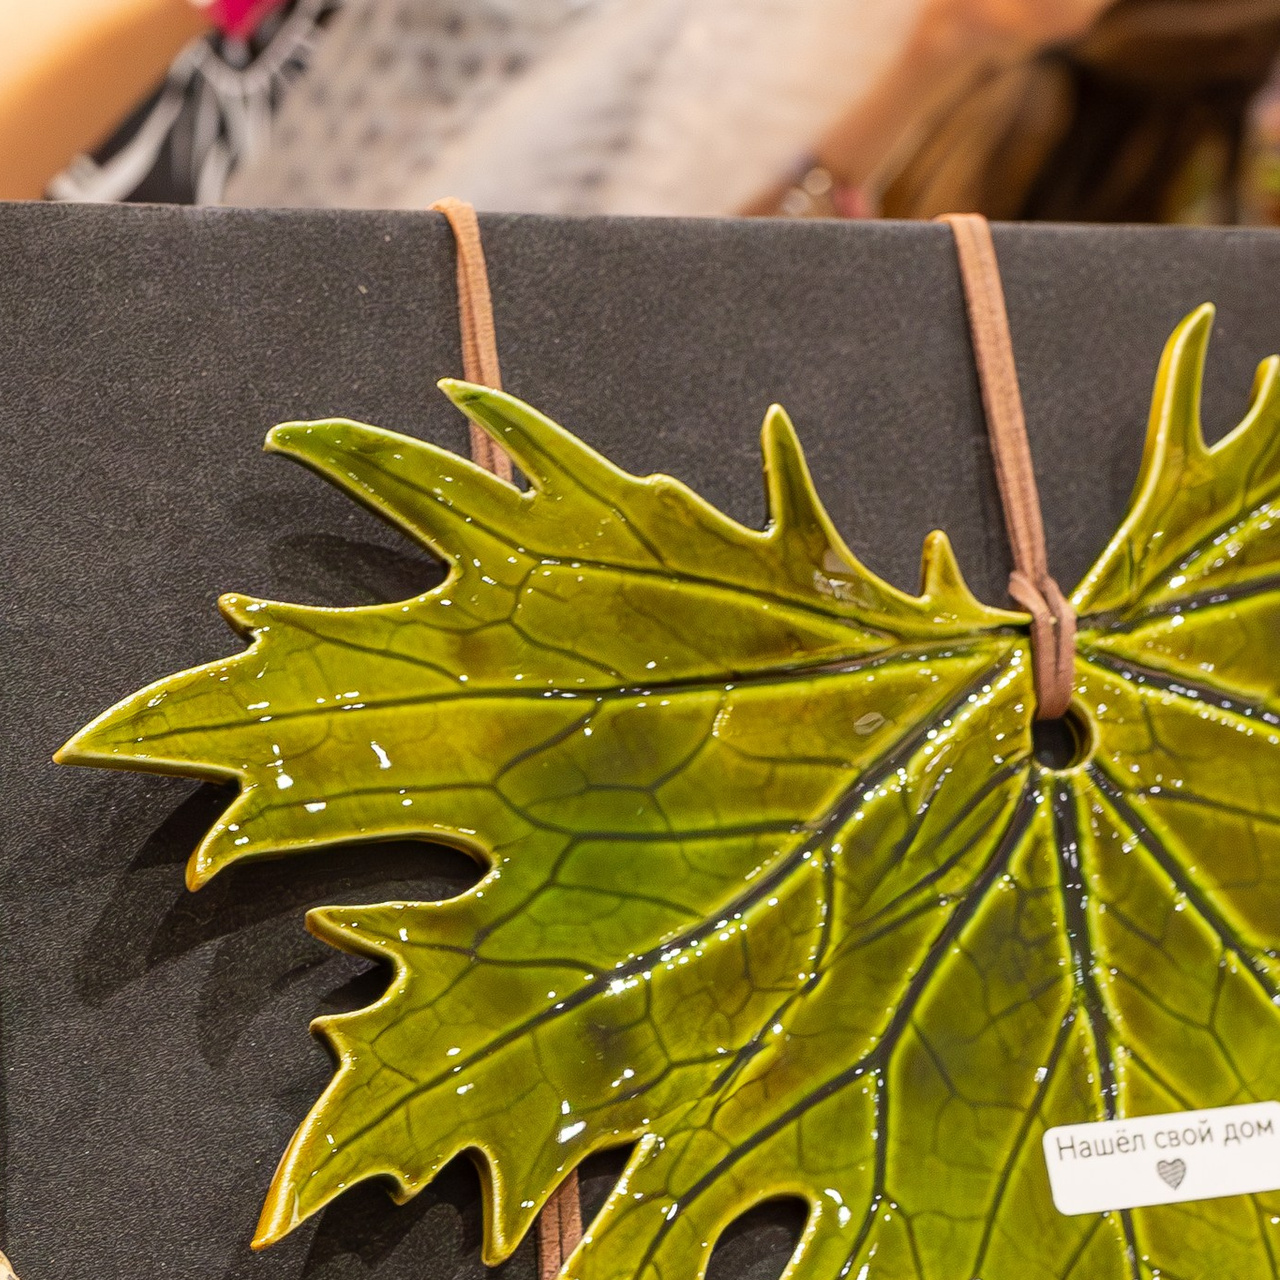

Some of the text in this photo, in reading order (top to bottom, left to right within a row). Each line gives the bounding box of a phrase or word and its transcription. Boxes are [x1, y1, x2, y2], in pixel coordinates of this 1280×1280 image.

[1056, 1118, 1275, 1161] Нашёл свой дом
